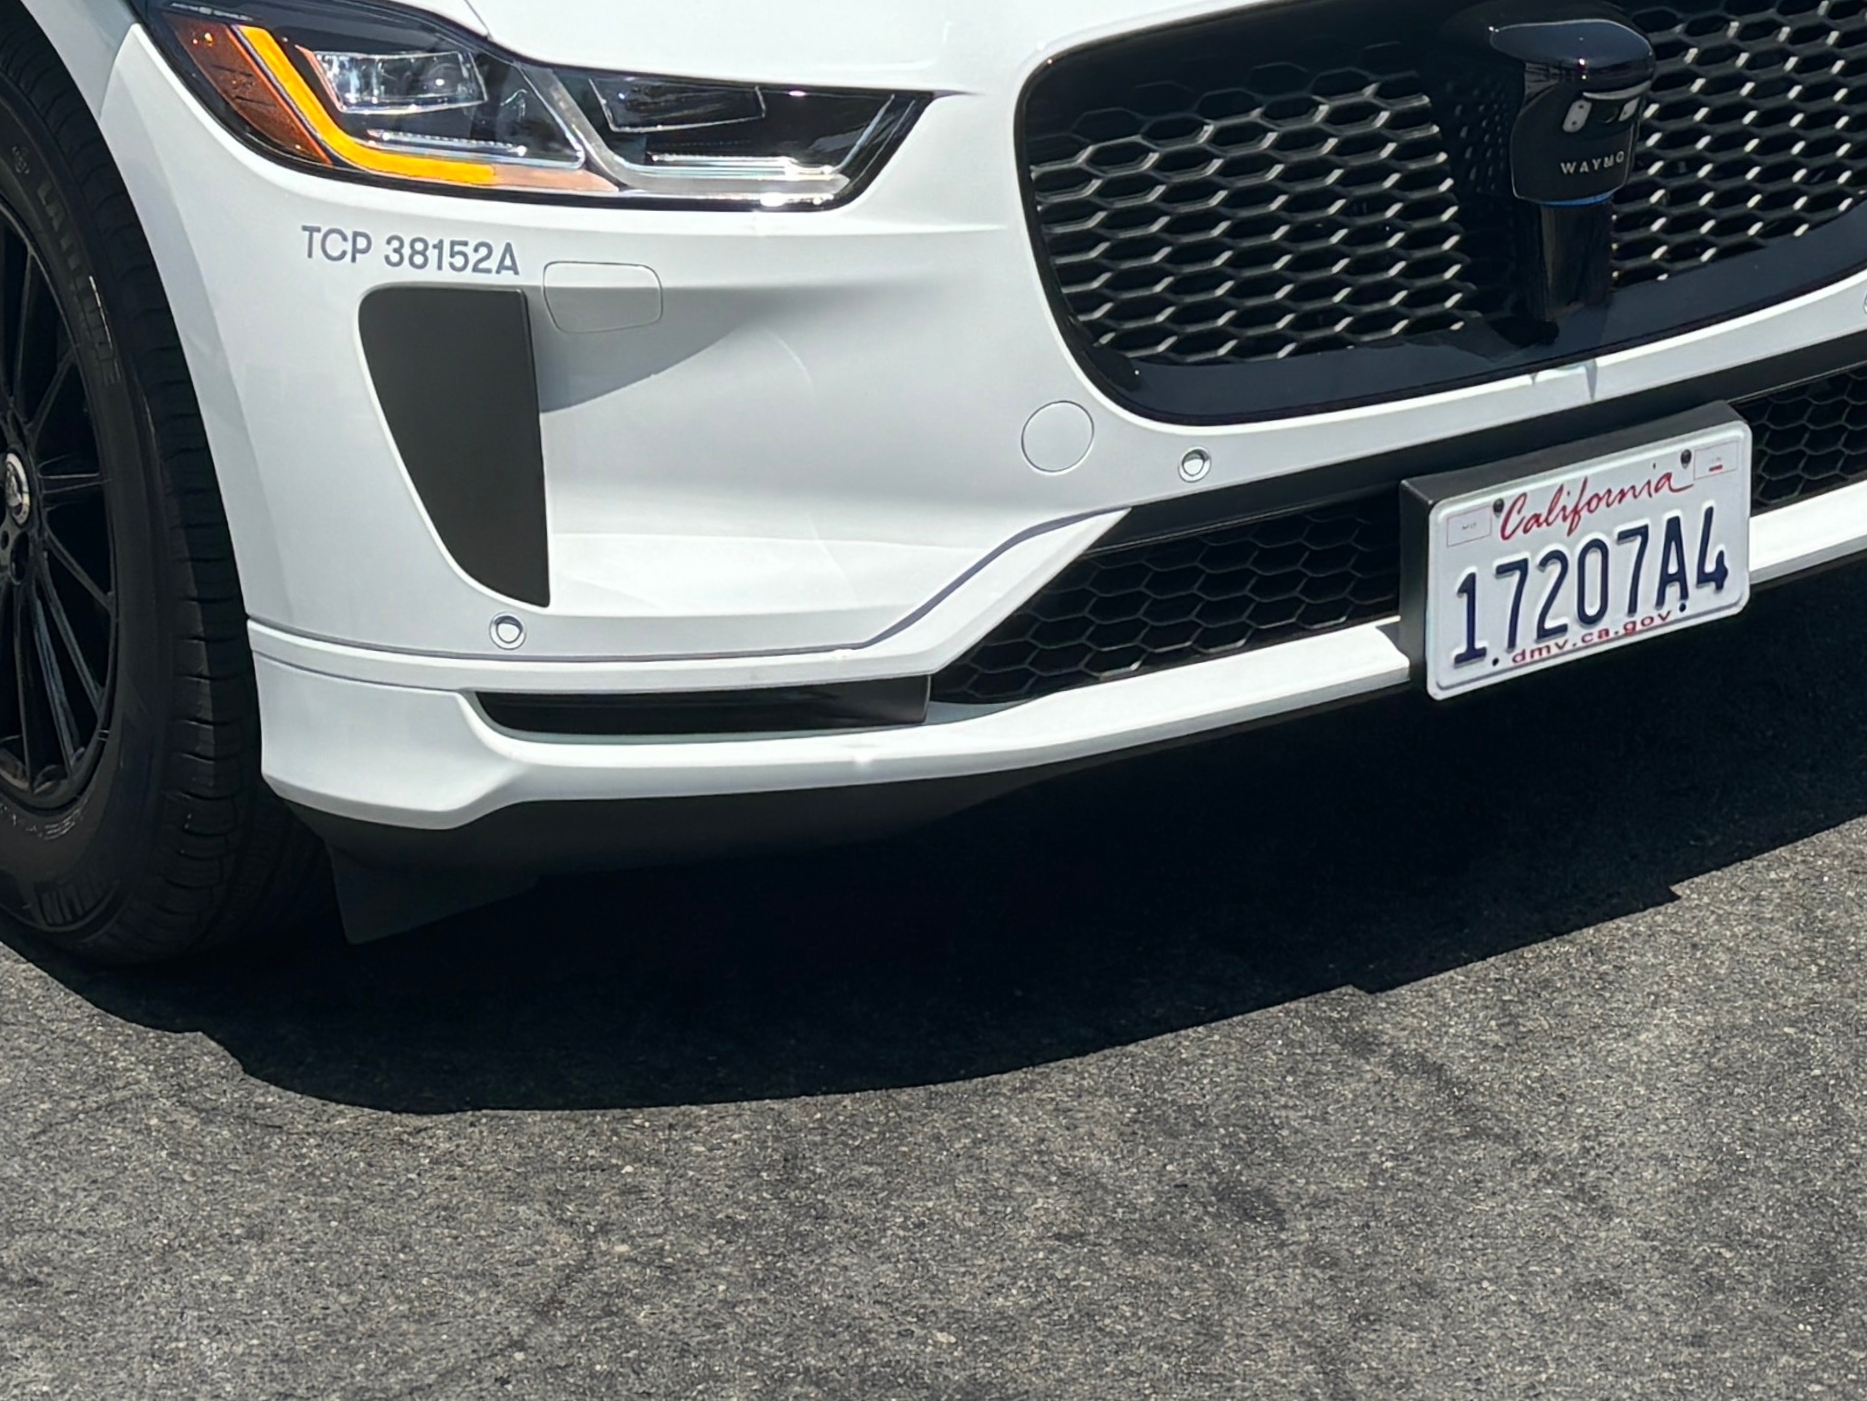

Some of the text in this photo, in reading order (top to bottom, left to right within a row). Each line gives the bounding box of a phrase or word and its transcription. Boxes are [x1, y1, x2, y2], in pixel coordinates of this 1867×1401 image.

[1560, 150, 1625, 175] WAYMO
[301, 224, 520, 276] TCP 38152A
[1499, 471, 1694, 541] California
[1453, 504, 1729, 666] 17207A4
[1511, 610, 1672, 665] dmv.ca.gov
